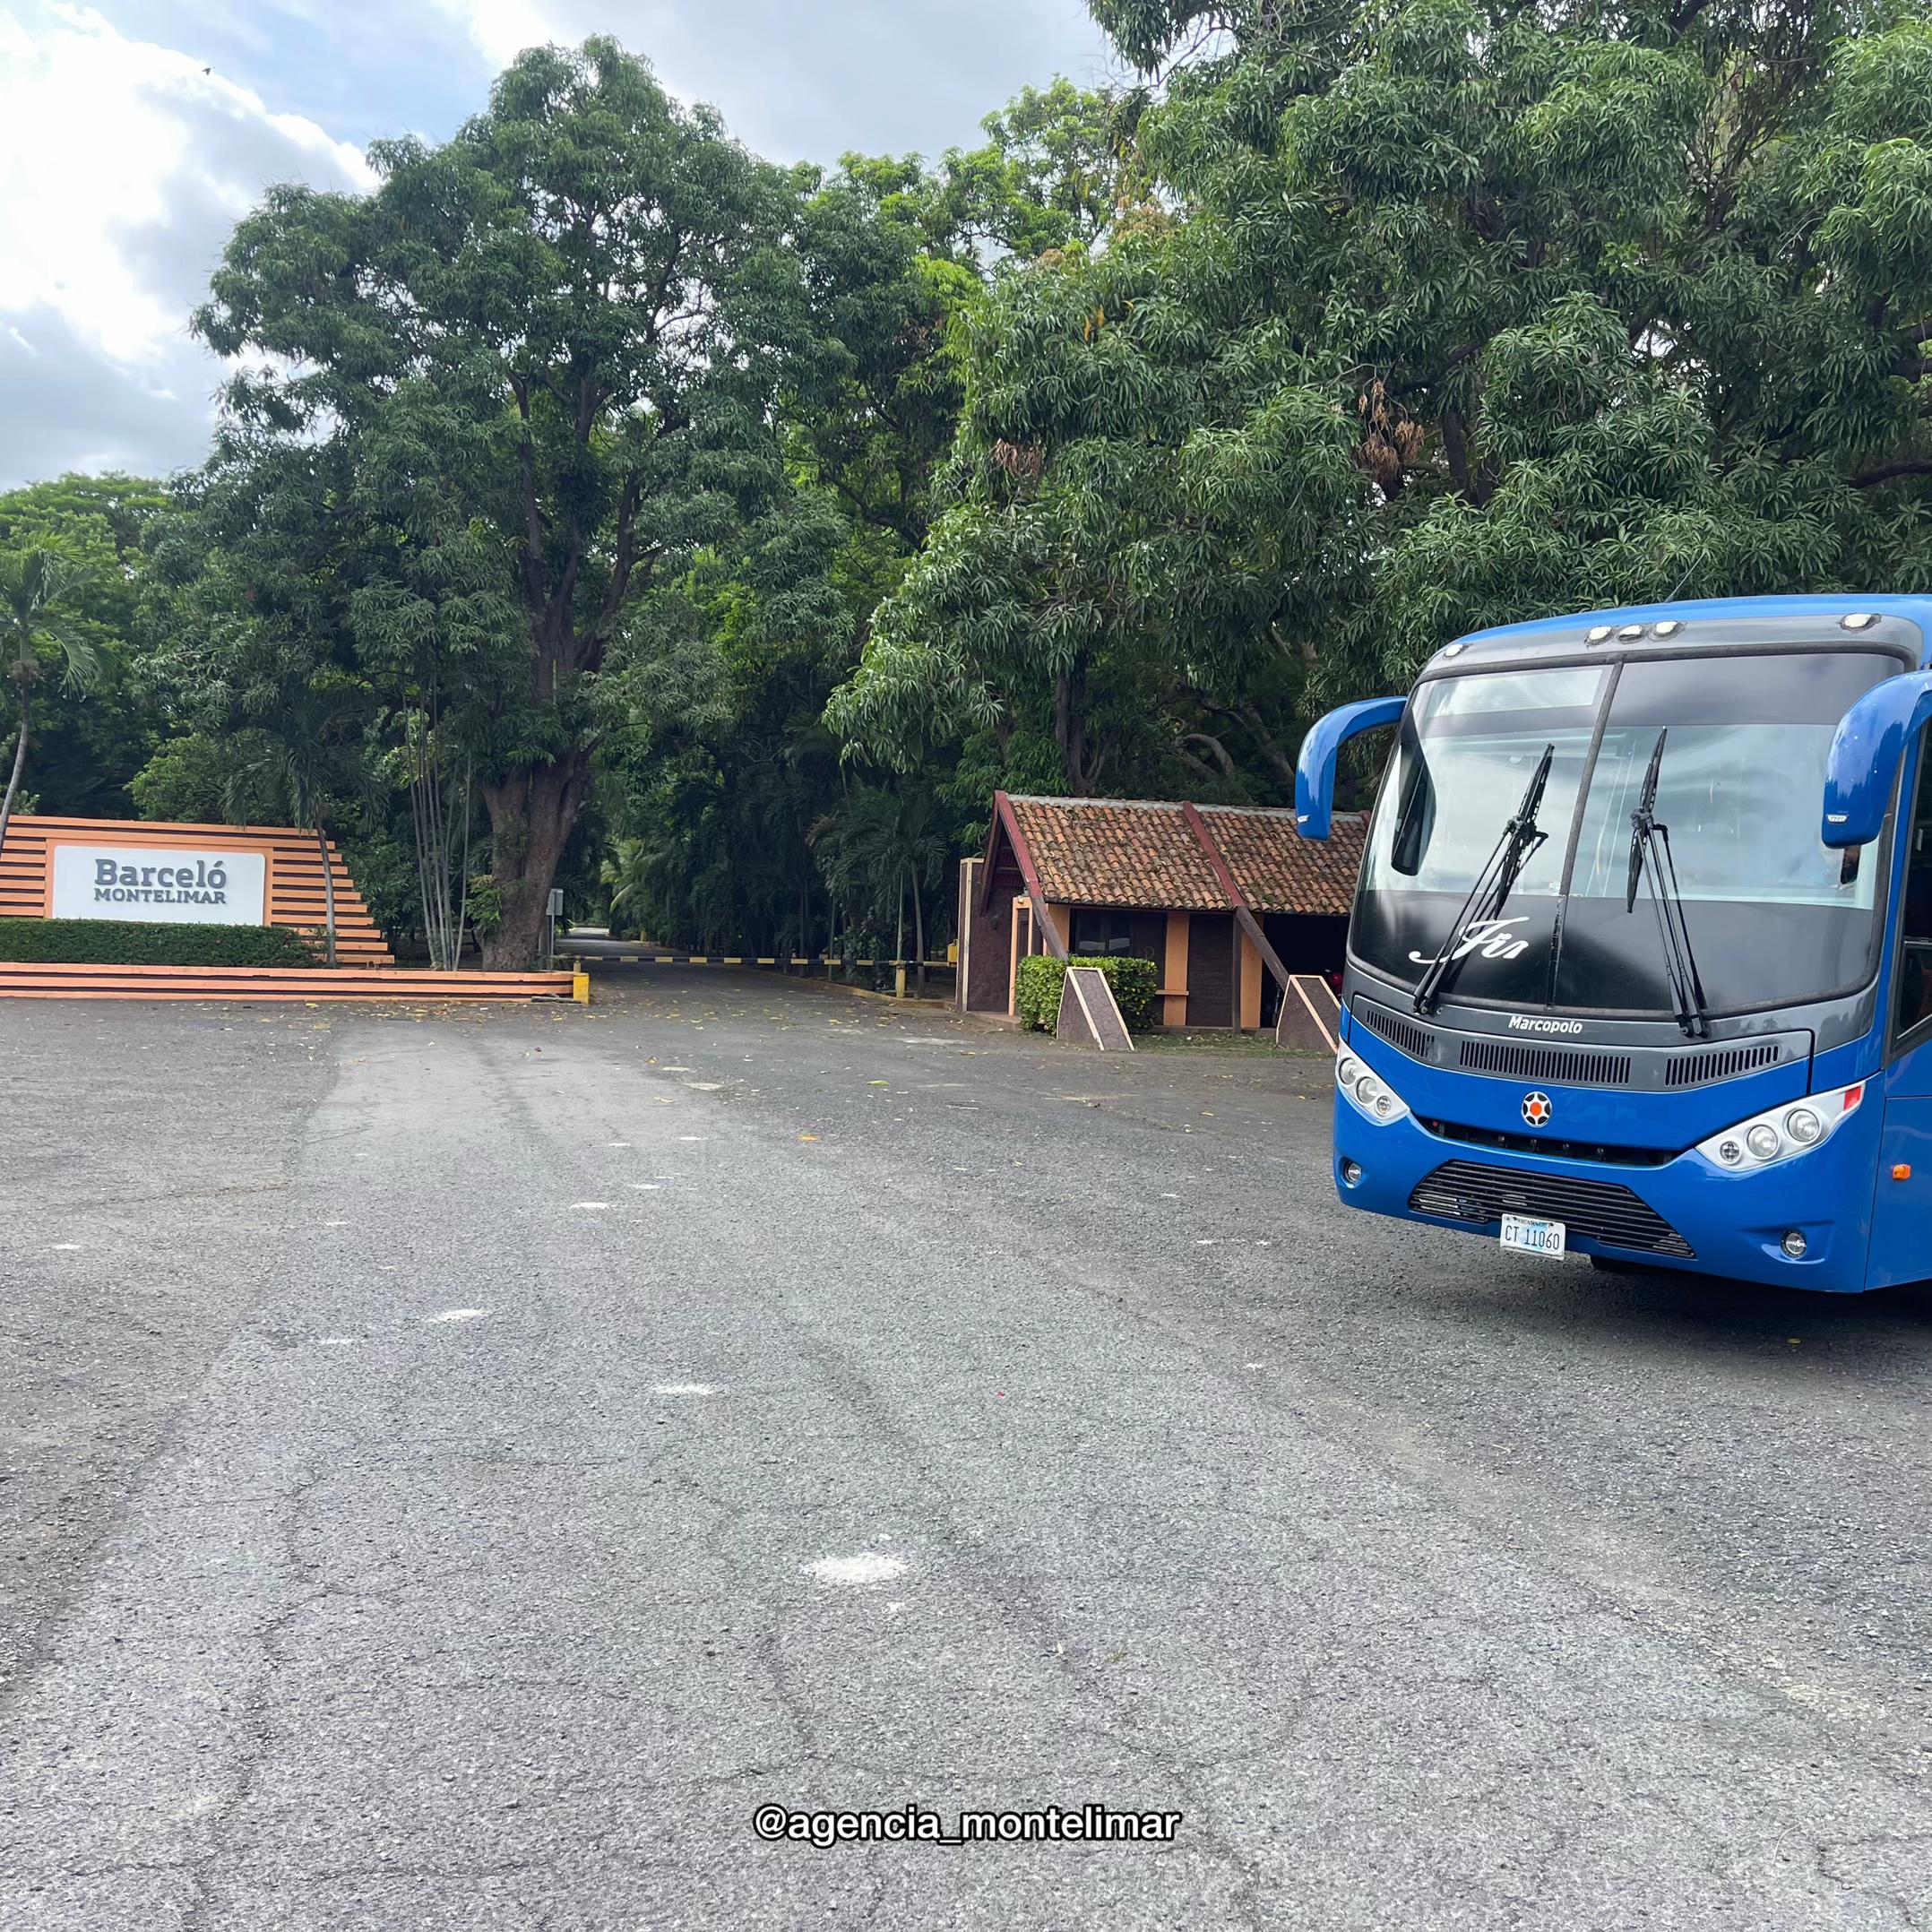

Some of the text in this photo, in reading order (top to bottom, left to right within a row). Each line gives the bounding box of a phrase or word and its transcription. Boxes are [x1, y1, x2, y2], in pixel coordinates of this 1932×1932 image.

[94, 858, 227, 889] Barceló
[93, 887, 227, 904] MONTELIMAR
[1508, 1015, 1583, 1034] Marcopolo
[1505, 1225, 1560, 1250] CT 11060
